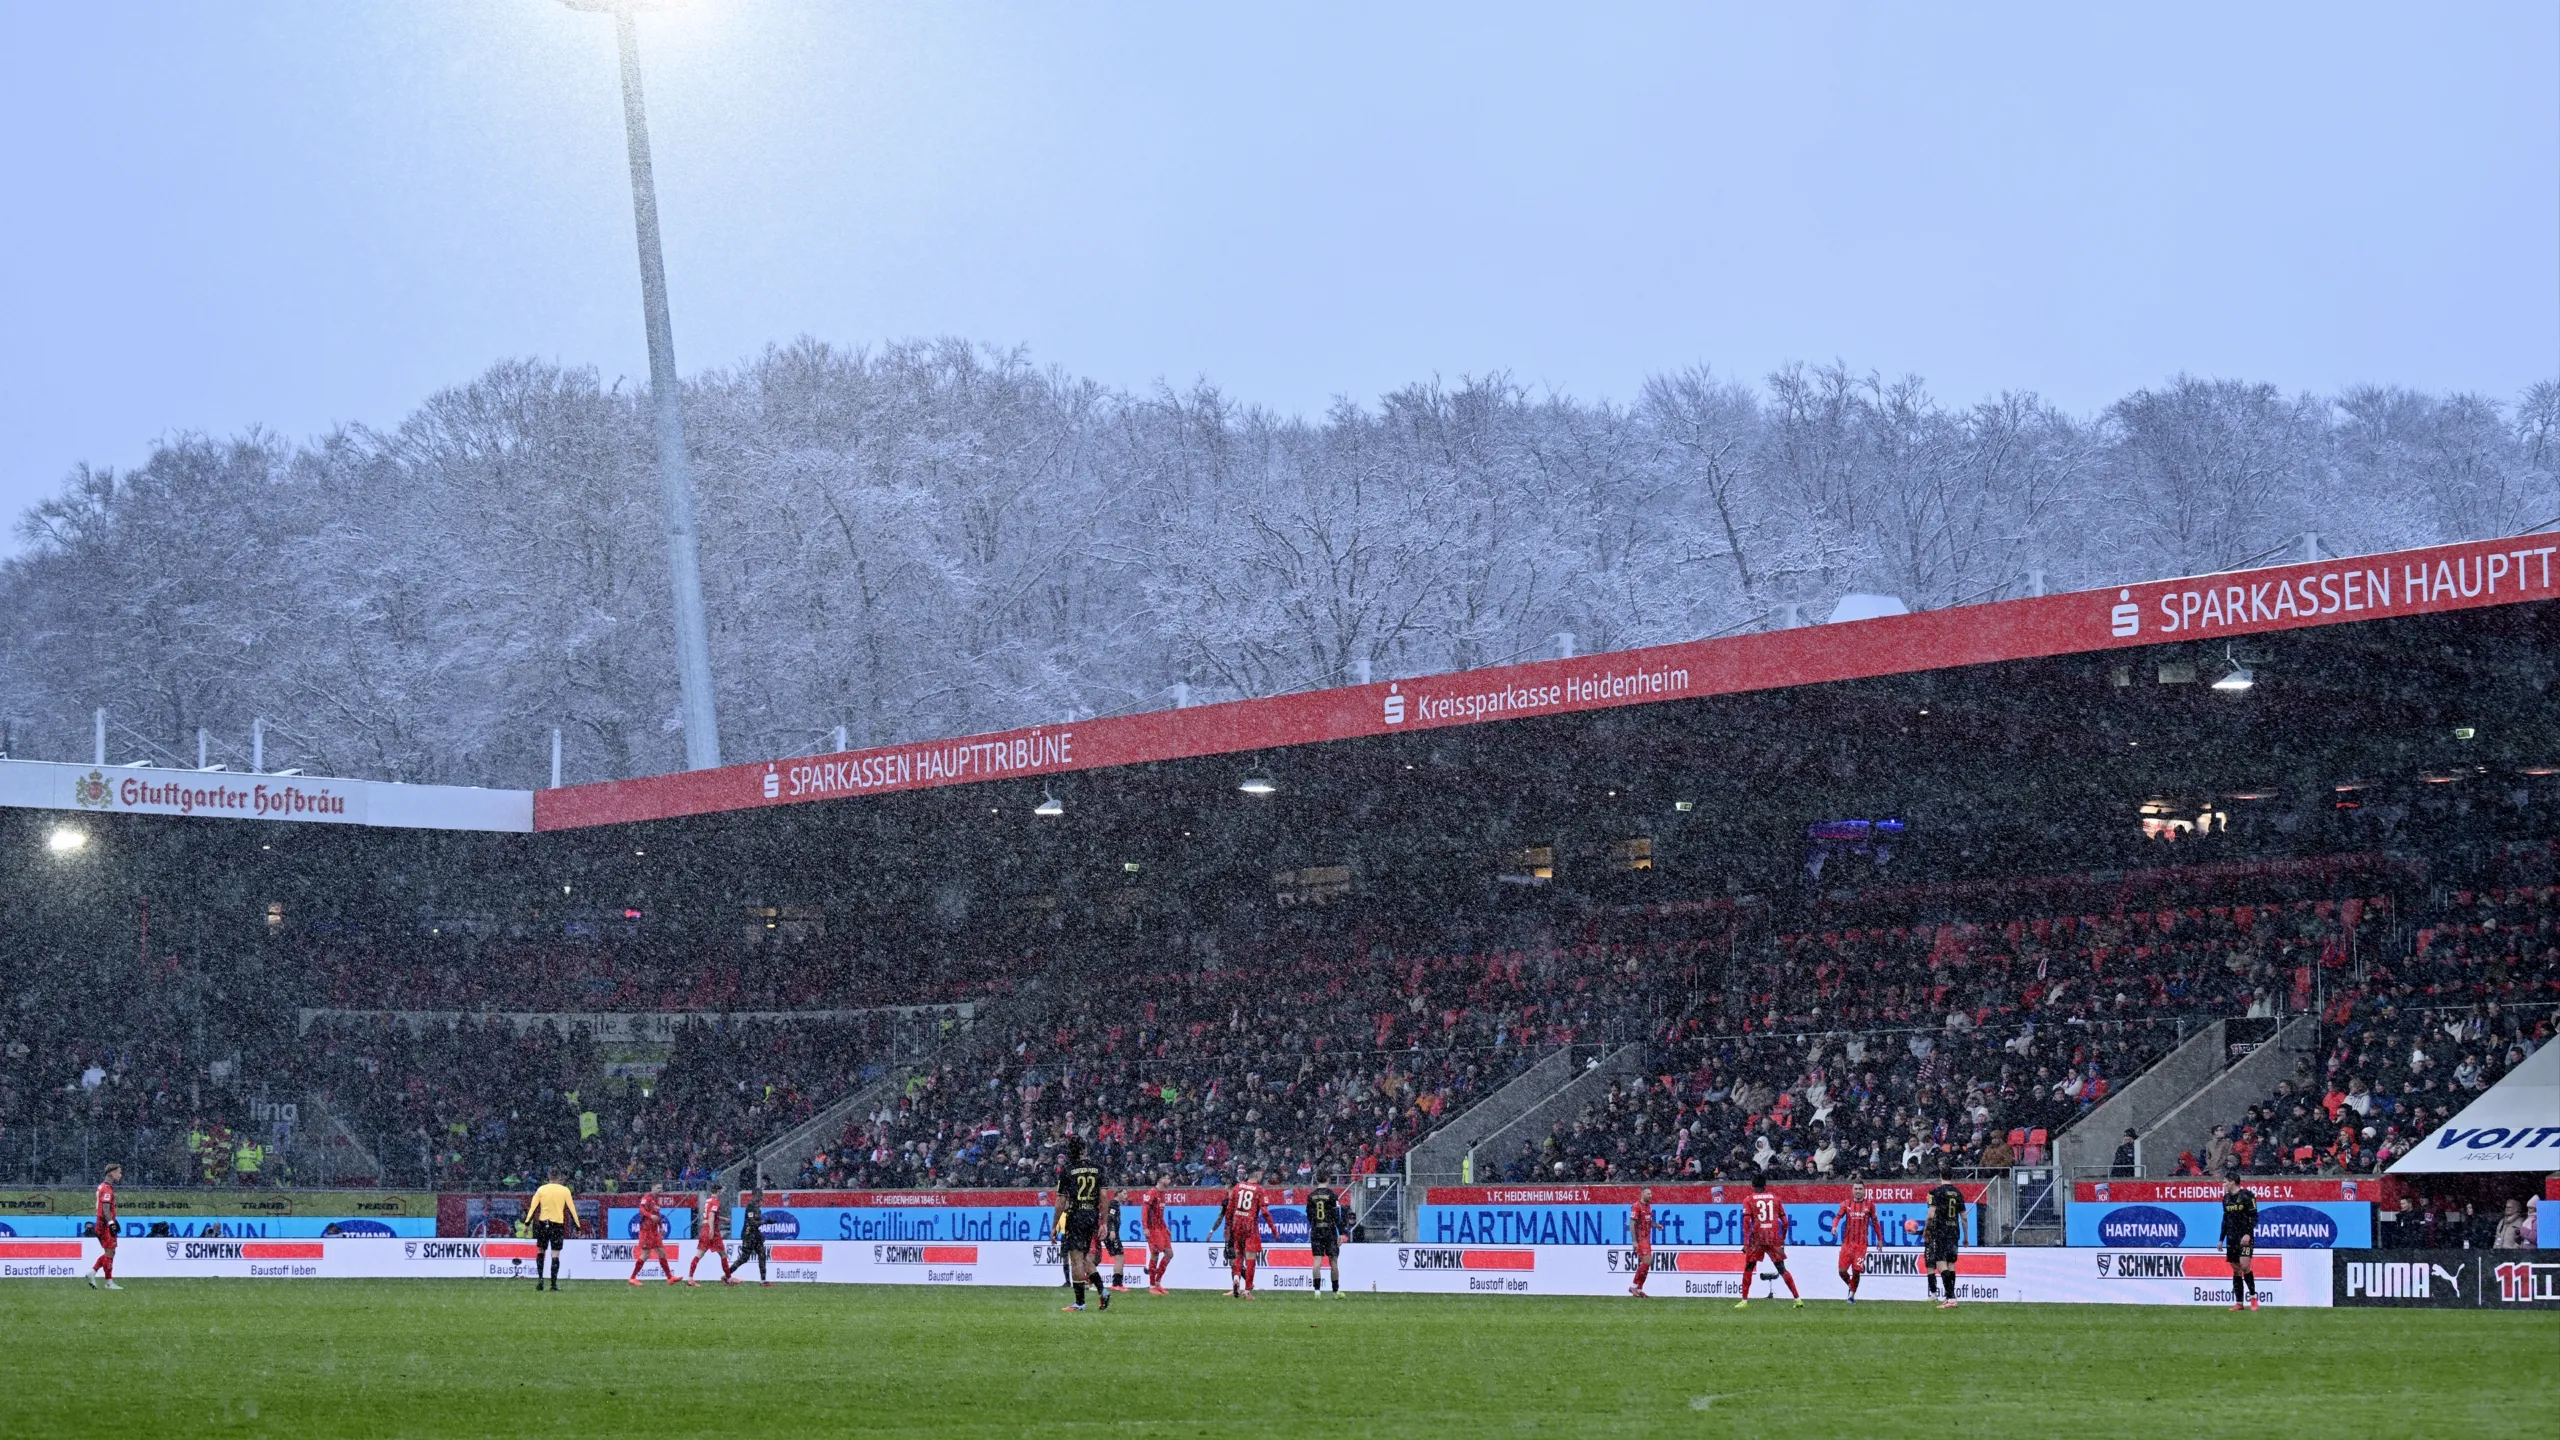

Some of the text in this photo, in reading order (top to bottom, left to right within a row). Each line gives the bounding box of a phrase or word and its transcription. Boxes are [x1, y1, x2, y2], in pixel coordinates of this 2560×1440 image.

[2160, 546, 2557, 633] SPARKASSEN HAUPTT
[1418, 664, 1689, 721] Kreissparkasse Heidenheim
[789, 730, 1073, 796] SPARKASSEN HAUPTTRIBÜNE
[120, 777, 345, 816] Stuttgarter Hofbräu
[2459, 1152, 2514, 1161] ARENA
[1077, 1175, 1096, 1200] 22
[1875, 1188, 1893, 1200] DER
[1895, 1188, 1912, 1200] FCH
[2165, 1186, 2176, 1198] FC
[2178, 1185, 2225, 1198] HEIDENH
[883, 1195, 920, 1204] HEIDENHEIM
[1173, 1194, 1185, 1202] FCH
[1237, 1190, 1254, 1211] 18
[1493, 1190, 1503, 1201] FC
[1504, 1190, 1554, 1202] HEIDENHEIM
[1555, 1190, 1573, 1201] 1846
[1316, 1201, 1325, 1220] 8
[1756, 1199, 1774, 1222] 31
[1948, 1198, 1957, 1218] 6
[951, 1211, 992, 1241] Und
[1000, 1211, 1030, 1241] die
[1258, 1222, 1308, 1234] HATMANN
[1437, 1210, 1610, 1245] HARTMANN.
[2105, 1223, 2179, 1238] HARTMANN
[2253, 1223, 2330, 1238] HARTMANN
[185, 1243, 243, 1259] SCHWENK
[423, 1243, 481, 1258] SCHWENK
[601, 1244, 634, 1260] SCHWENK
[886, 1246, 923, 1263] SCHWENK
[1414, 1249, 1463, 1269] SCHWENK
[2118, 1254, 2184, 1277] SCHWENK
[4, 1264, 75, 1276] Baustoff leben
[250, 1264, 317, 1276] Baustoff leben
[928, 1270, 973, 1282] Baustoff leben
[1273, 1274, 1304, 1288] Baustoff
[1469, 1277, 1528, 1291] Baustoff leben
[1685, 1280, 1743, 1294] Baustoff lebe
[2346, 1262, 2430, 1298] PUMA
[1971, 1284, 1999, 1299] leben
